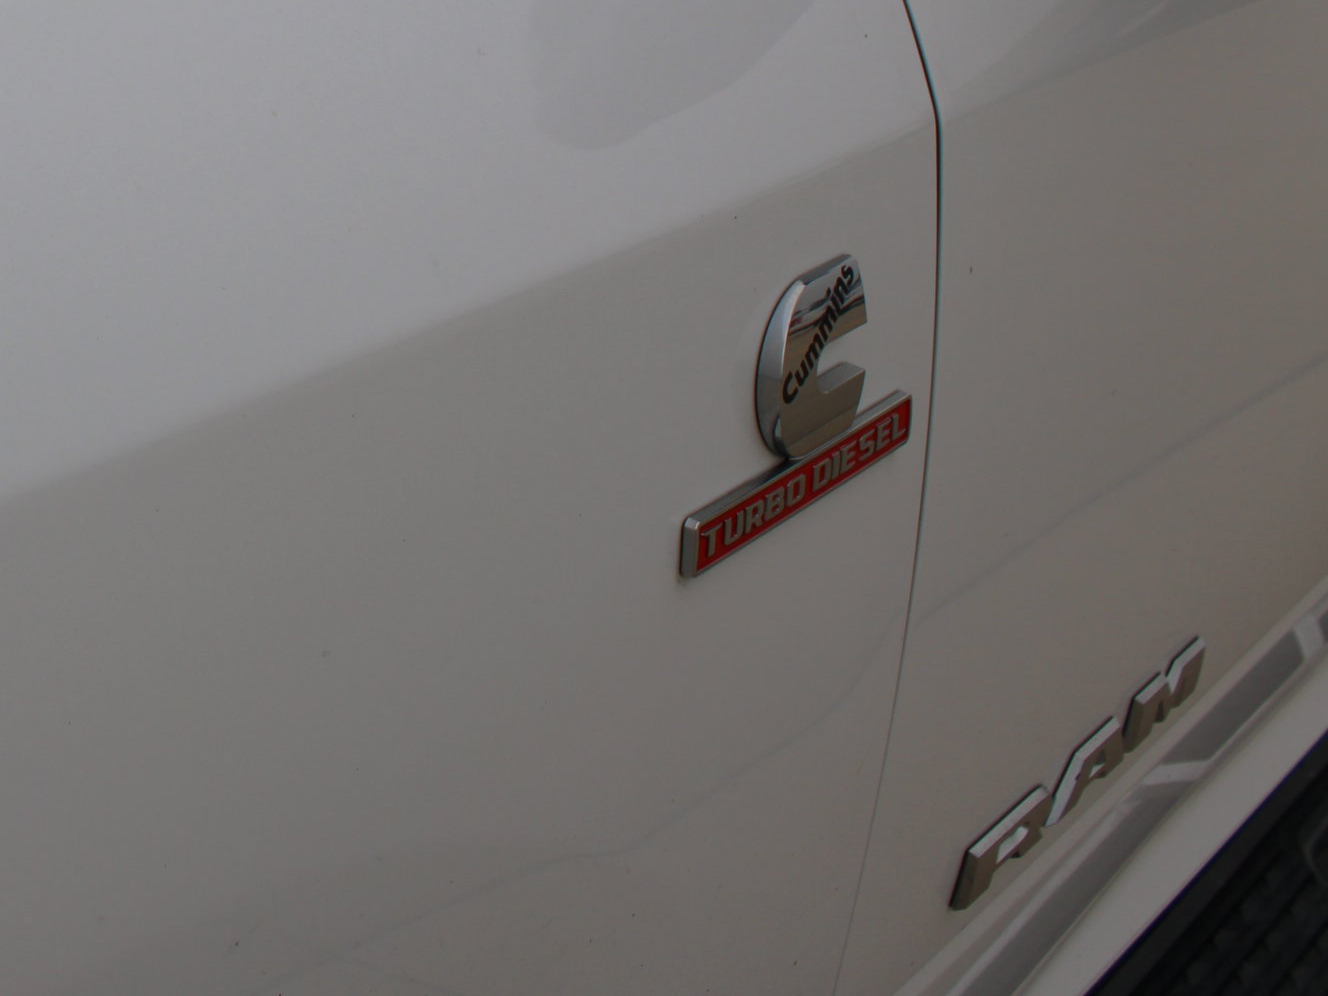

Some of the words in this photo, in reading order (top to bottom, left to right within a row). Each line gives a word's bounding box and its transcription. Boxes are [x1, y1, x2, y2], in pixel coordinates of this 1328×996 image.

[782, 264, 854, 404] Cummins
[699, 474, 806, 558] TURBO
[812, 412, 907, 493] DIESEL
[949, 636, 1206, 911] RAM
